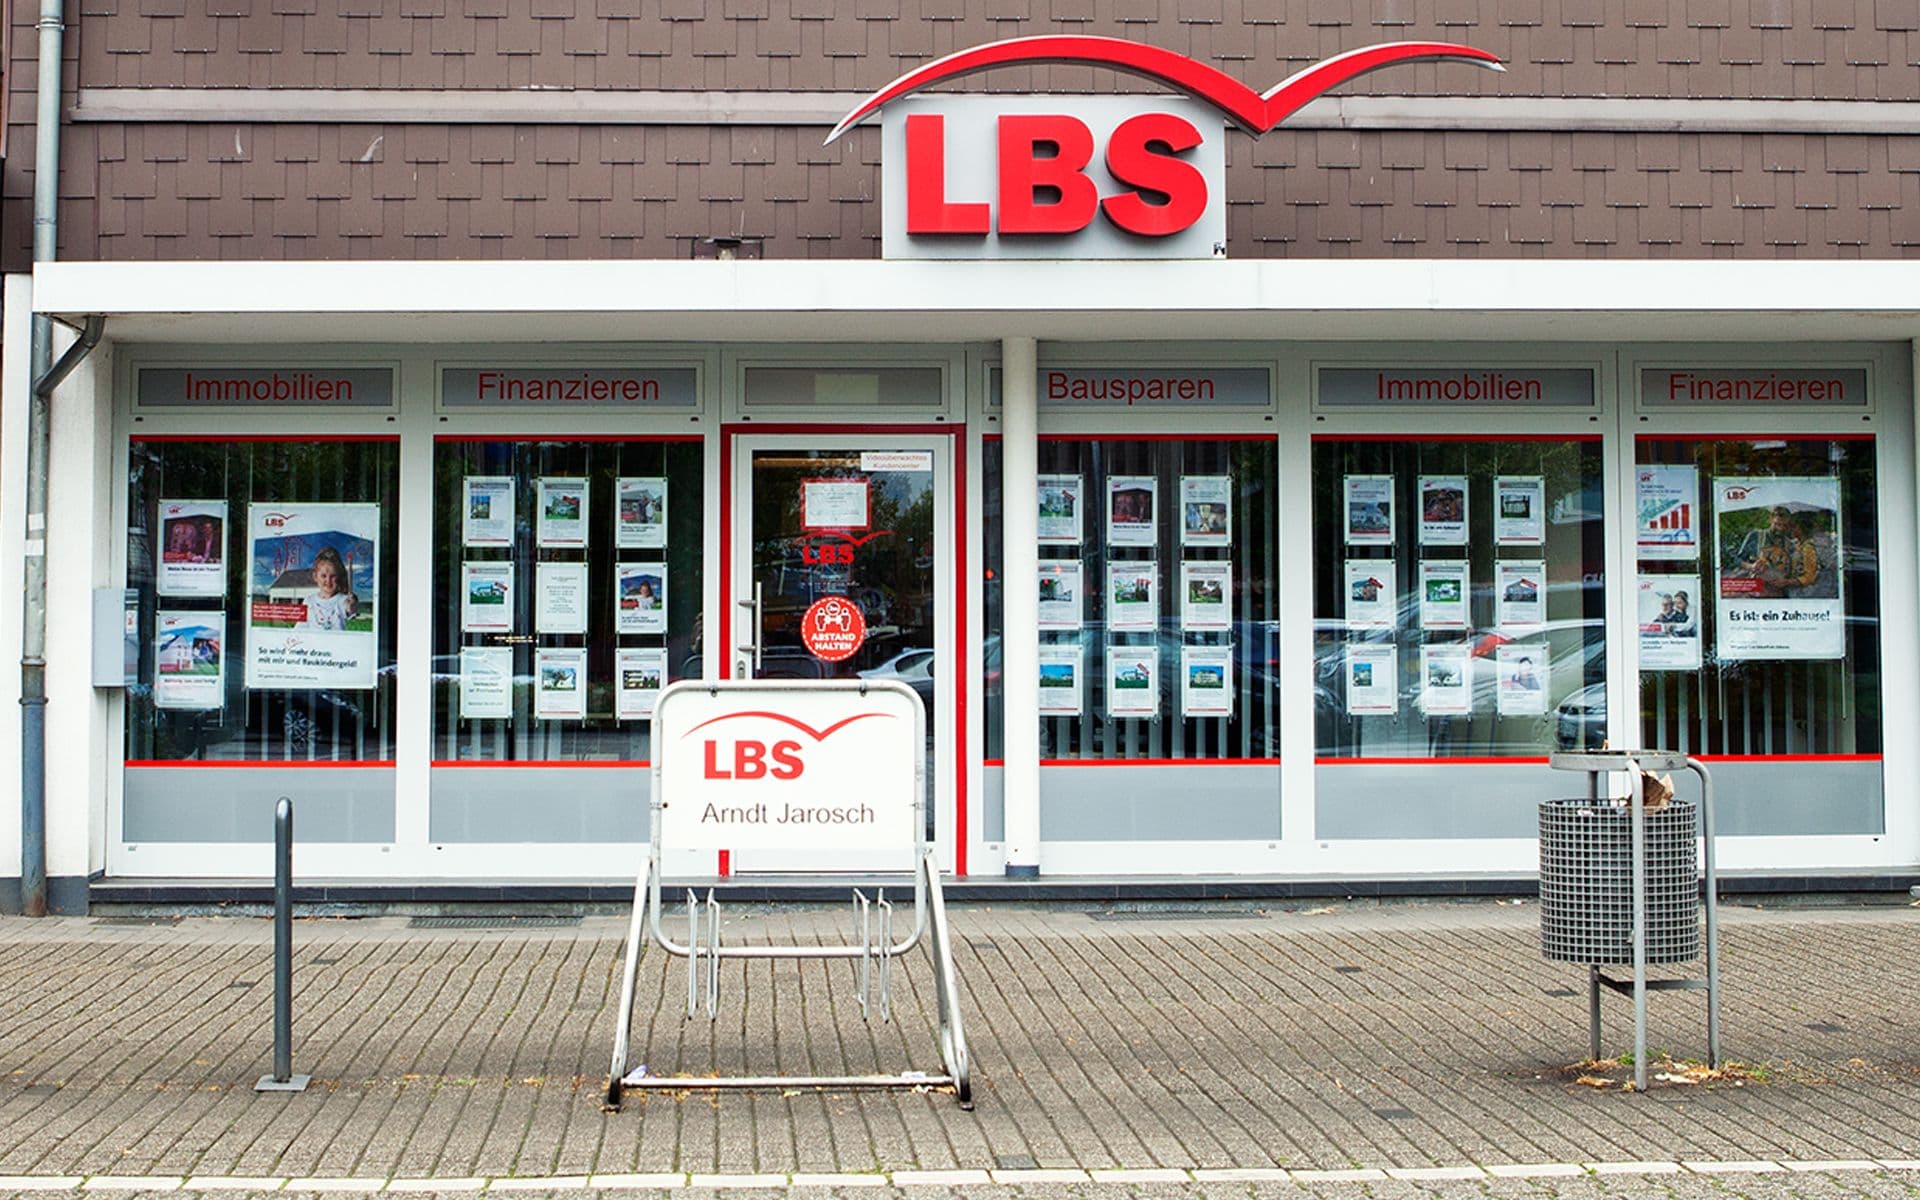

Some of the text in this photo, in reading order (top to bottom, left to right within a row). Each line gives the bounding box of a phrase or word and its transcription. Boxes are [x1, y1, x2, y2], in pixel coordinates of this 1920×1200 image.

[906, 112, 1208, 236] LBS
[187, 374, 352, 400] Immobilien
[479, 374, 659, 400] Finanzieren
[1048, 374, 1214, 406] Bausparen
[1378, 374, 1541, 400] Immobilien
[1670, 375, 1843, 400] Finanzieren
[1727, 491, 1747, 500] LBS
[265, 518, 285, 527] LBS
[802, 544, 855, 565] LBS
[1729, 610, 1741, 621] Es
[1762, 610, 1779, 621] ein
[811, 633, 856, 642] ABSTAND
[815, 642, 853, 651] HALTEN
[704, 739, 805, 780] LBS
[701, 803, 875, 824] Arndt Jarosch
